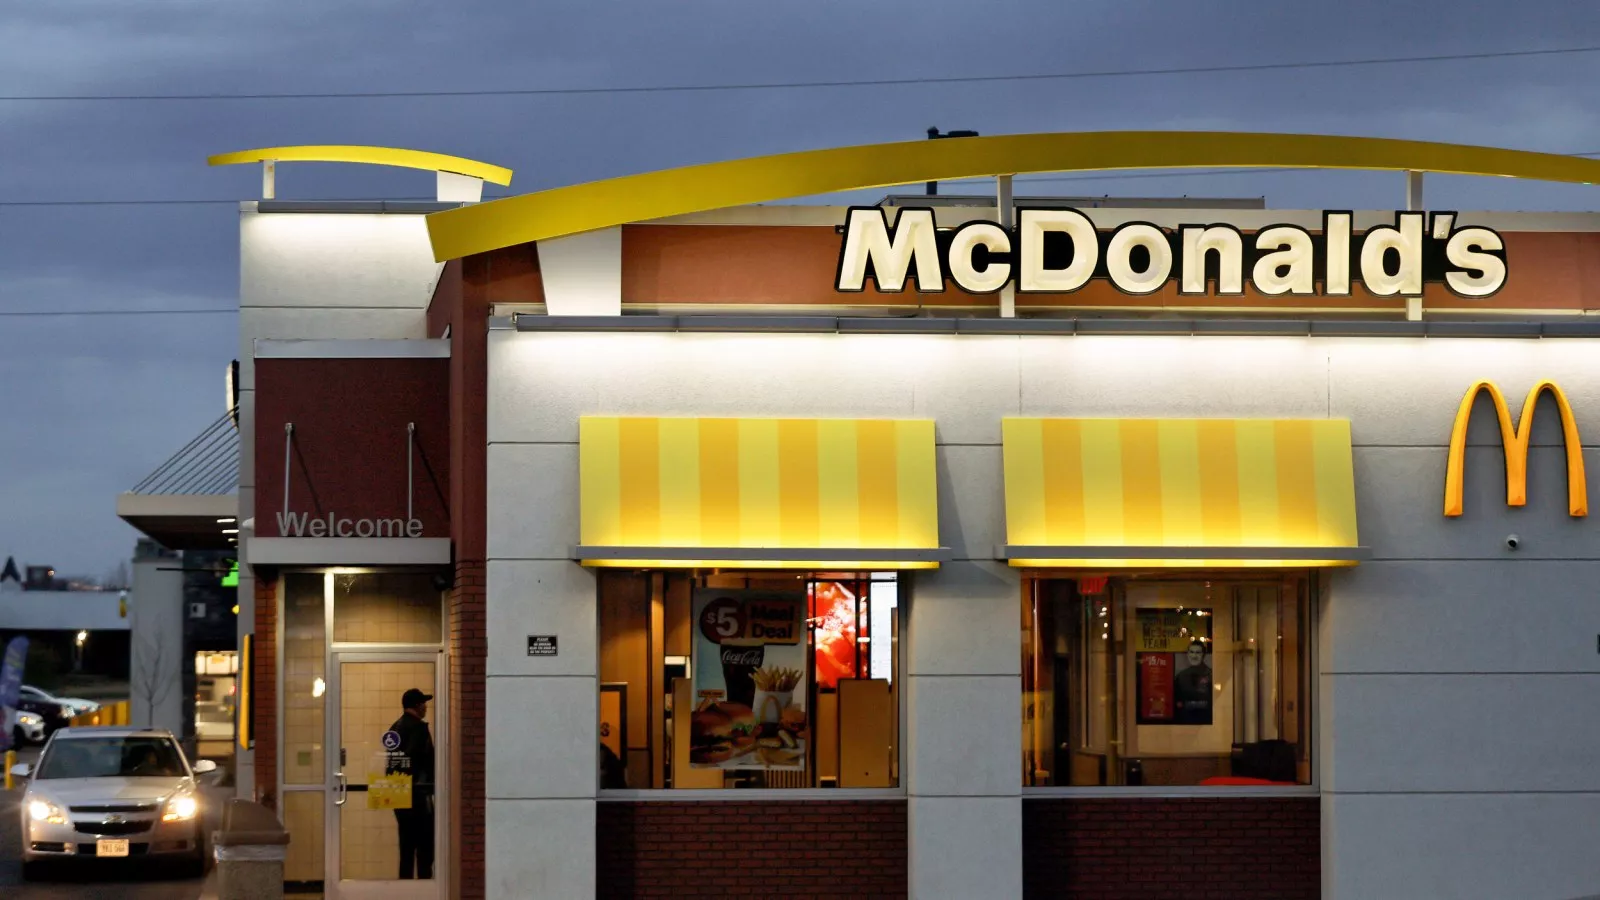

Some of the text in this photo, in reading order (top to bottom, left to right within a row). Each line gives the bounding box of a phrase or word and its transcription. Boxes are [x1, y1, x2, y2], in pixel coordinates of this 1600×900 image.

[836, 205, 1507, 299] McDonald's
[276, 511, 424, 538] Welcome
[706, 606, 740, 637] $5
[750, 604, 795, 621] Meal
[751, 622, 793, 639] Deal
